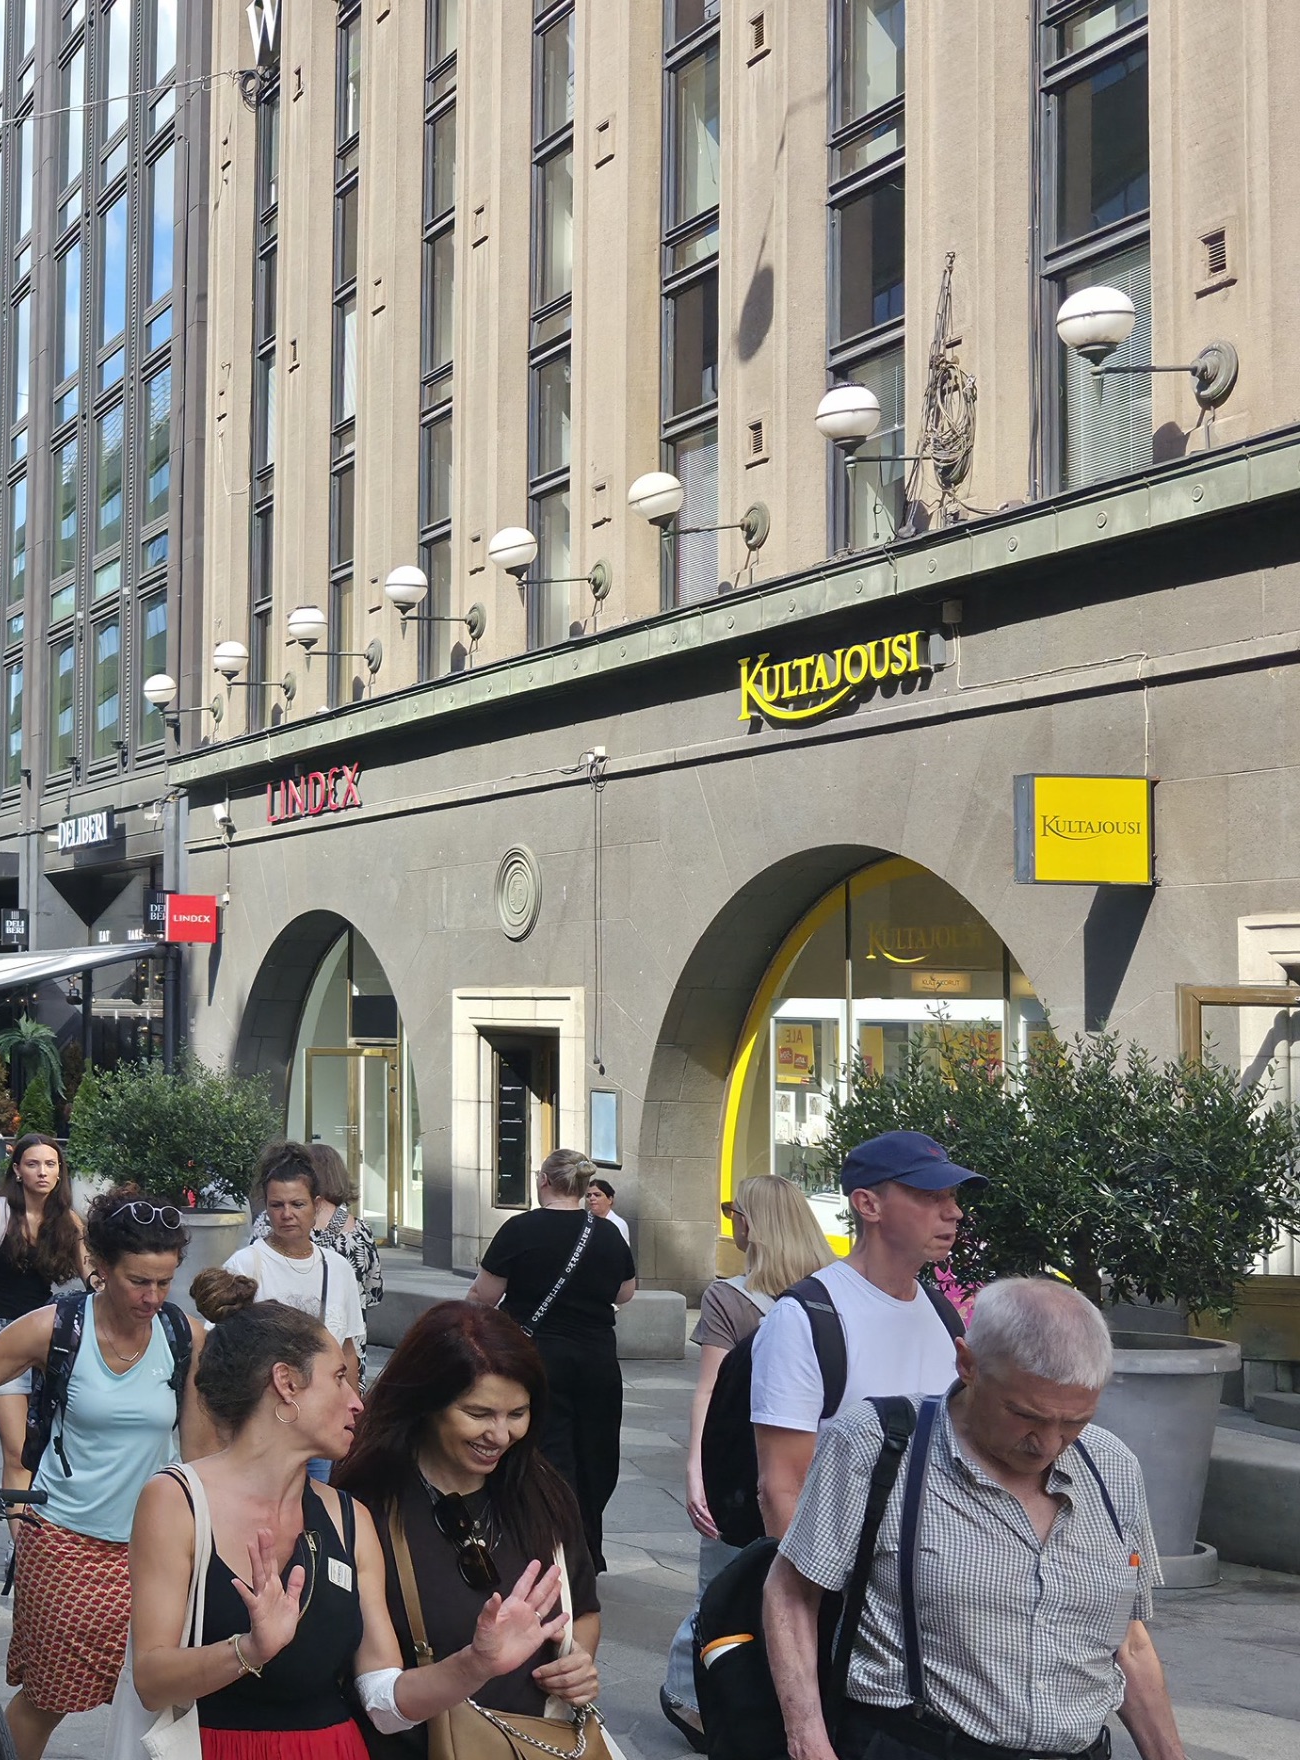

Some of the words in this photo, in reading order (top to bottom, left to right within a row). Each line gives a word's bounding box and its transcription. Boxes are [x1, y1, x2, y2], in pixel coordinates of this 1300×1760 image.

[737, 631, 920, 721] KULTAJOUSI
[267, 762, 361, 823] LINDEX
[58, 811, 108, 850] DELIBERI
[1040, 815, 1141, 840] KULTAJOUSI
[5, 920, 25, 928] DELI
[173, 914, 210, 923] LINDEX
[565, 1226, 591, 1273] marimekko
[531, 1277, 566, 1322] marimekko
